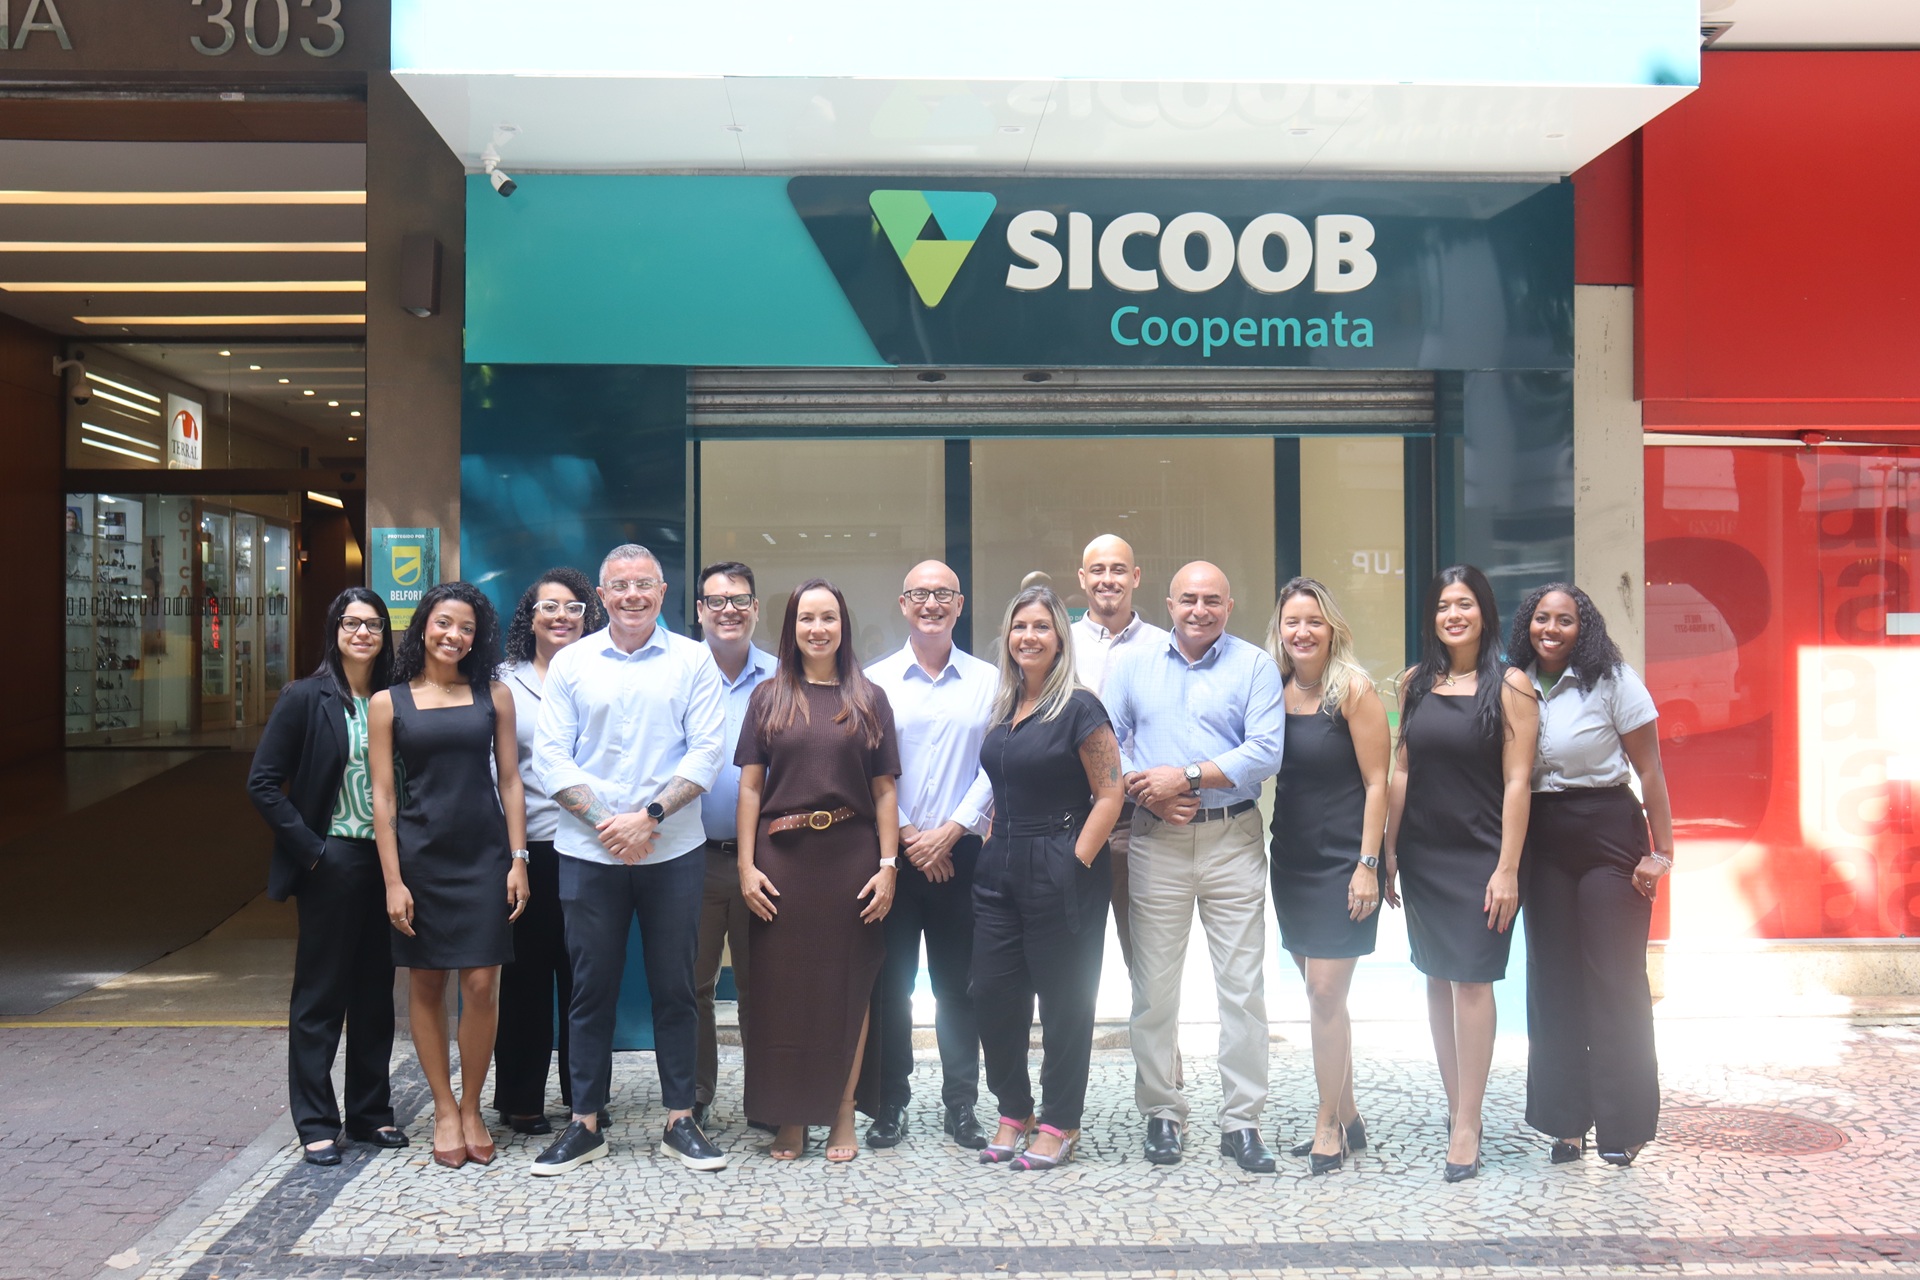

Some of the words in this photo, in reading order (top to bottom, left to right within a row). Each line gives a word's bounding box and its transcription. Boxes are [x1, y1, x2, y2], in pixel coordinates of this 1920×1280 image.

[0, 0, 73, 50] A
[190, 0, 345, 57] 303
[1005, 210, 1378, 293] SICOOB
[1110, 305, 1374, 357] Coopemata
[172, 439, 198, 460] TERRAL
[178, 506, 191, 598] ÓTICA
[390, 590, 422, 601] BELFORT
